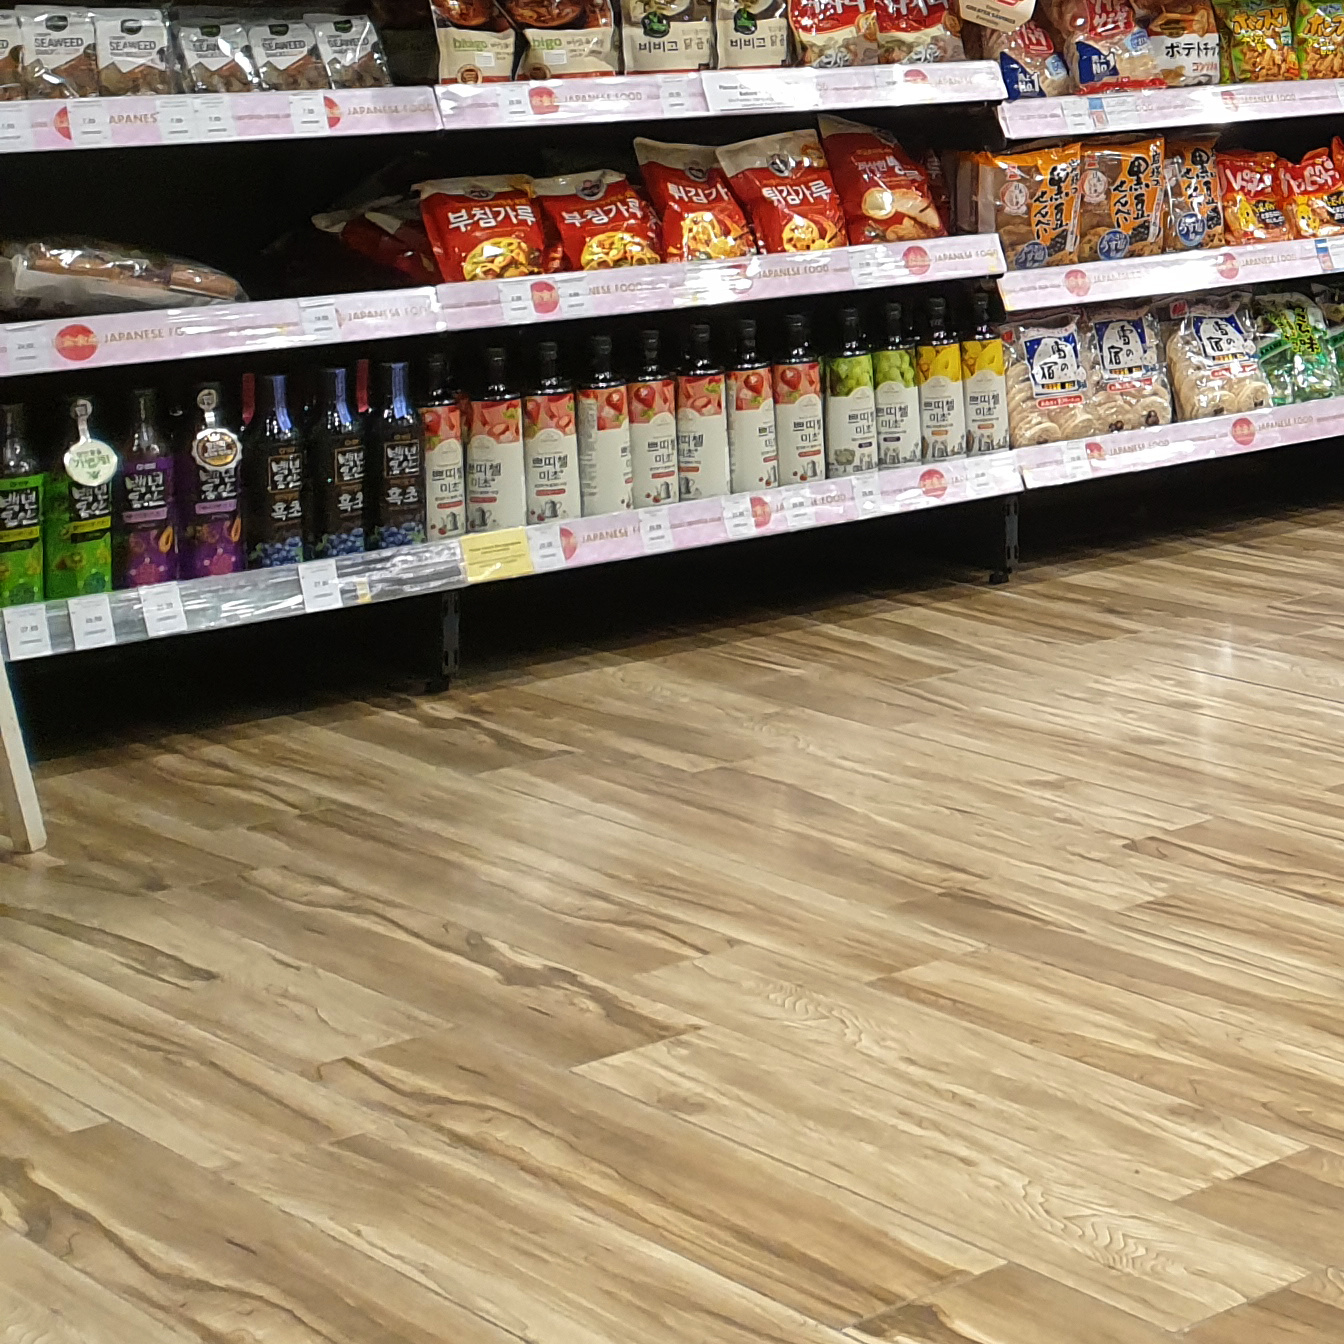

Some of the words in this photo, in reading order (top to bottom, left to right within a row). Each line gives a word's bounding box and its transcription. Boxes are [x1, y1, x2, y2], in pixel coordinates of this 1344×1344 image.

[34, 37, 84, 51] SEAWEED
[109, 39, 156, 52] SEAWEED
[448, 205, 537, 233] 부침가루
